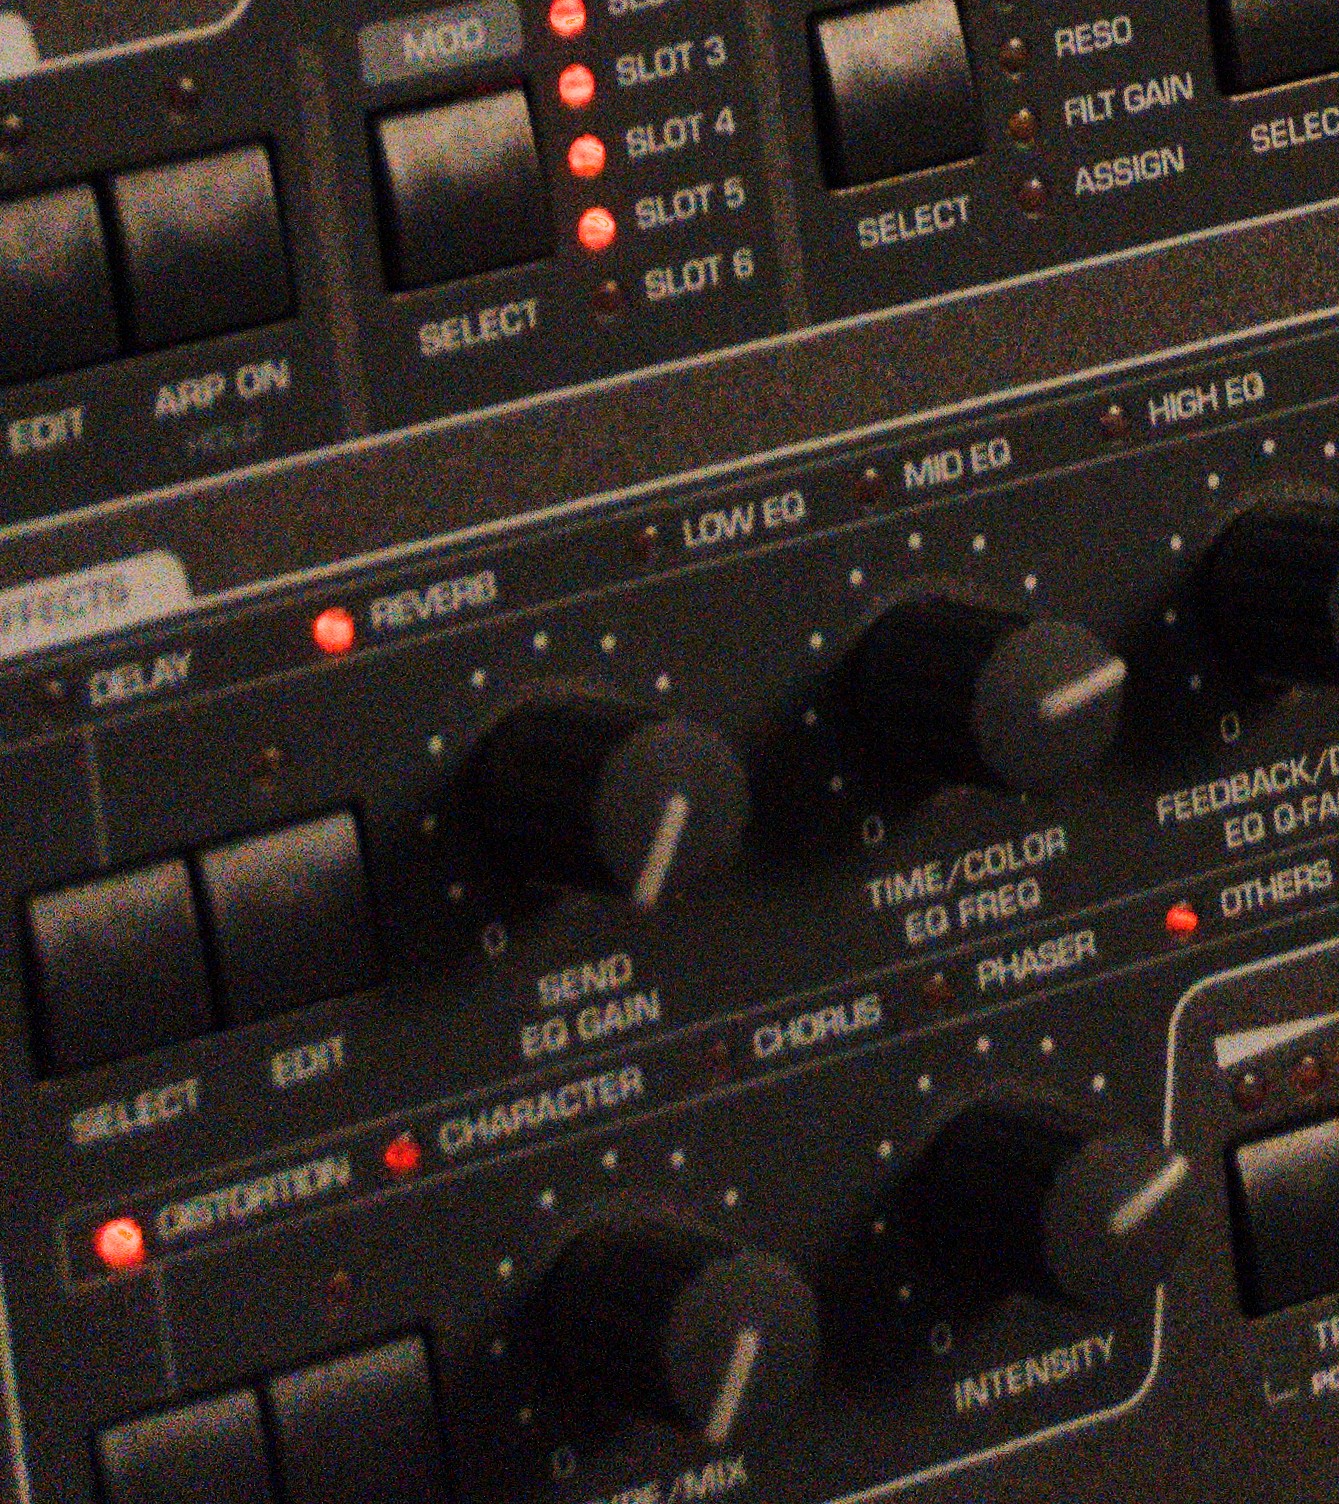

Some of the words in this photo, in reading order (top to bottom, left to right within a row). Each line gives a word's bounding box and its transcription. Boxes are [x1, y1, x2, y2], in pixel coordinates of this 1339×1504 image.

[401, 17, 486, 62] MOD
[615, 42, 693, 86] SLOT
[704, 36, 727, 67] 3
[1054, 15, 1133, 58] RESO
[1063, 88, 1116, 126] FILT
[1122, 73, 1194, 114] GAIN
[624, 114, 704, 158] SLOT
[714, 107, 736, 136] 4
[1075, 146, 1186, 195] ASSIGN
[857, 196, 970, 249] SELECT
[418, 299, 538, 357] SELECT
[1148, 384, 1218, 425] HIGH
[1225, 371, 1264, 407] EQ
[903, 449, 964, 488] MID
[970, 437, 1012, 474] EQ
[370, 571, 498, 629] REVERB
[866, 828, 1067, 915] TIME/COLOR
[1220, 859, 1333, 917] OTHERS
[976, 930, 1097, 989] PHASER
[753, 996, 882, 1059] CHORUS
[438, 1067, 644, 1154] CHARACTER
[156, 1158, 351, 1240] DISTORTION
[953, 1333, 1115, 1413] INTENSITY
